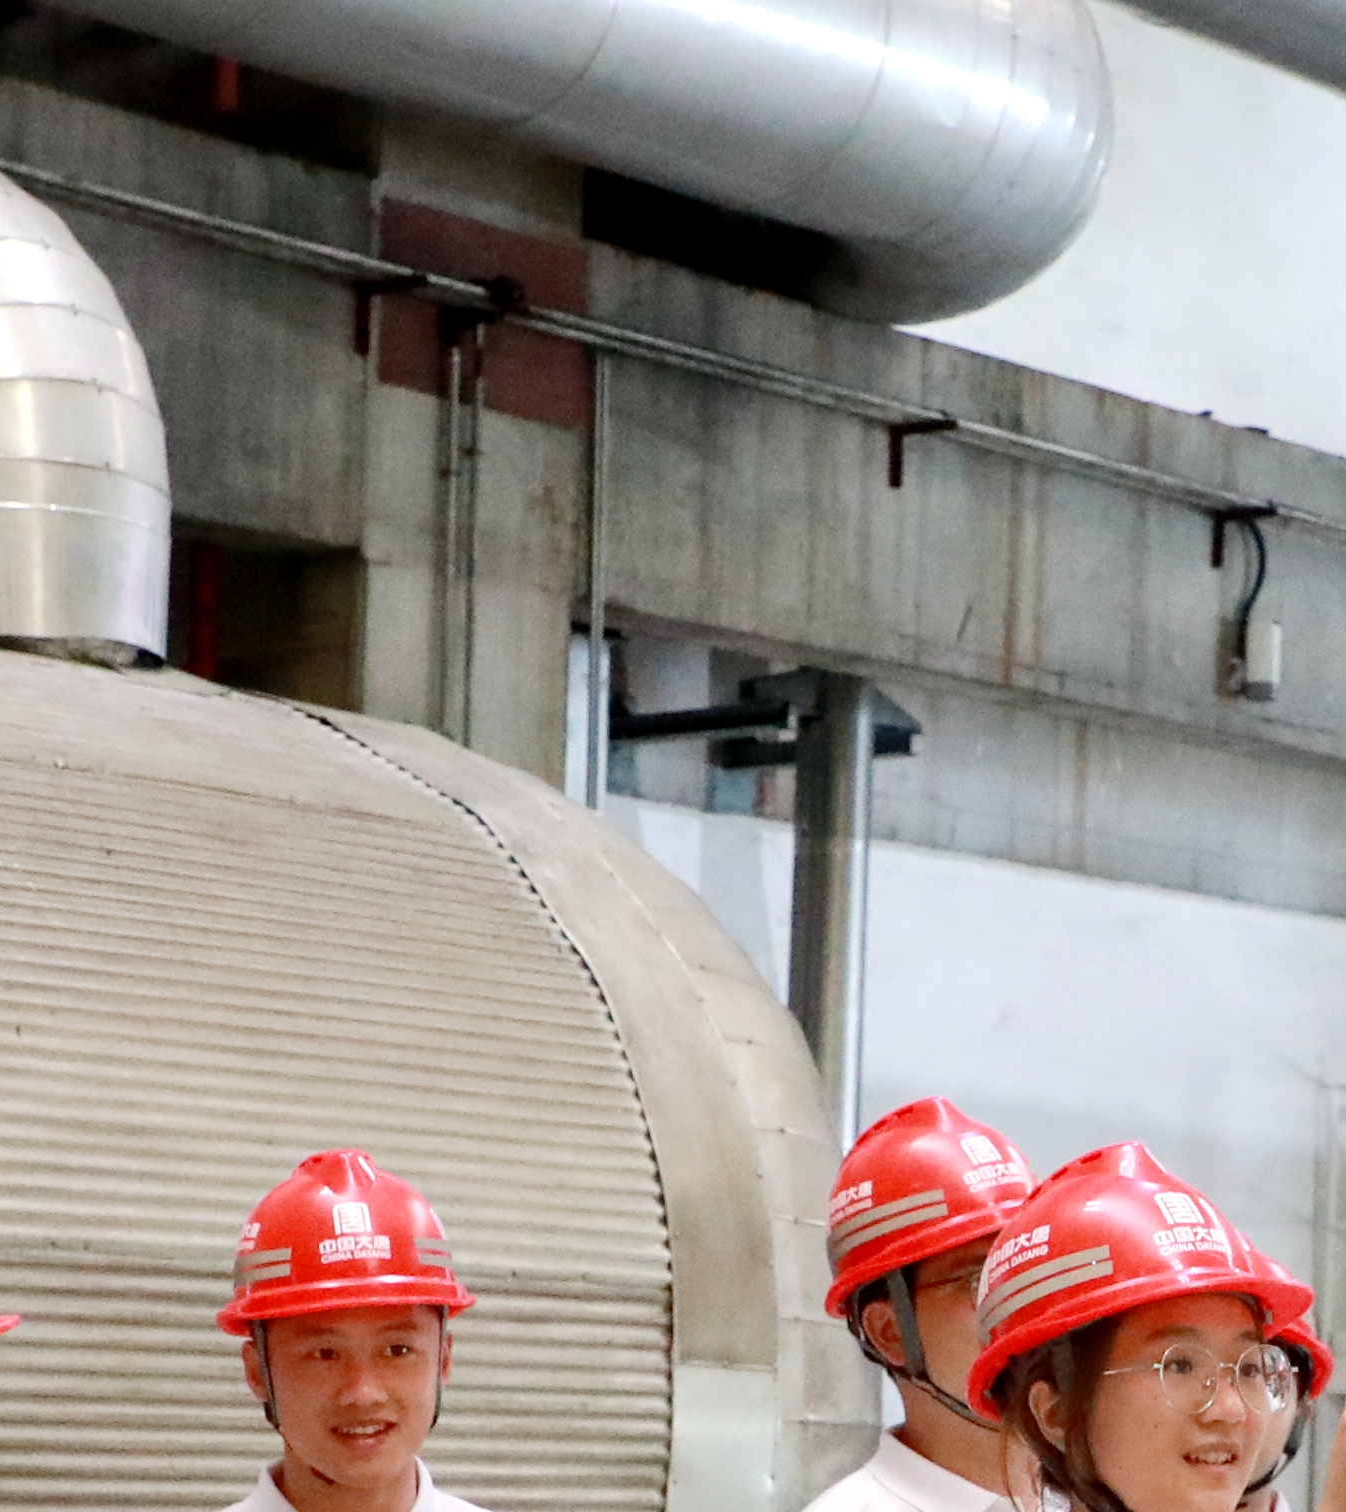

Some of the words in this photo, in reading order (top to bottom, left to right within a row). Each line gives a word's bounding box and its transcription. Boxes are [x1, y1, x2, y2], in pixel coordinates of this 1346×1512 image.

[318, 1235, 391, 1255] 中国大唐
[1159, 1242, 1196, 1257] CHINA
[321, 1250, 354, 1264] CHINA
[1010, 1244, 1049, 1269] DATANG
